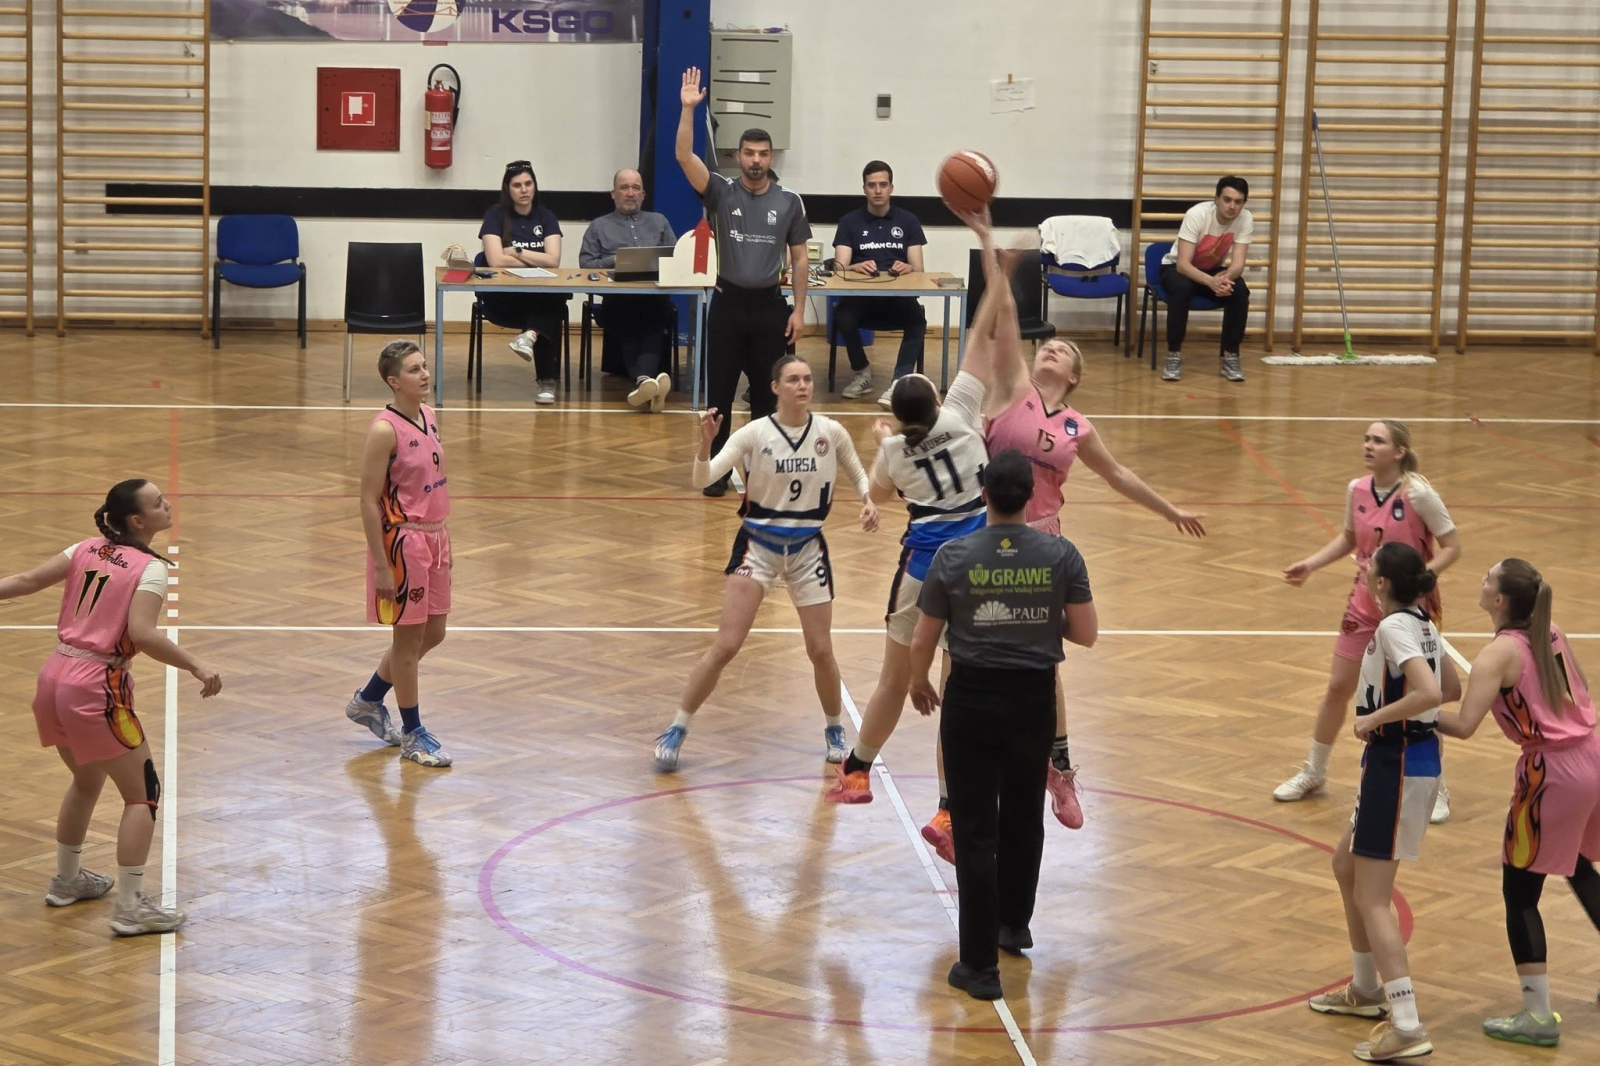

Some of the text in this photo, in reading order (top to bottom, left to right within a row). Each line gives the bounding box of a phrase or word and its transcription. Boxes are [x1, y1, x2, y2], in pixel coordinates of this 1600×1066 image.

[492, 10, 613, 33] KSGO
[1038, 428, 1056, 452] 15
[432, 451, 440, 472] 9
[775, 457, 817, 473] MURSA
[913, 447, 964, 501] 11
[789, 479, 802, 502] 9
[816, 566, 827, 587] 9
[991, 567, 1052, 586] GRAWE
[75, 569, 112, 618] 11
[1013, 606, 1050, 620] PAUN
